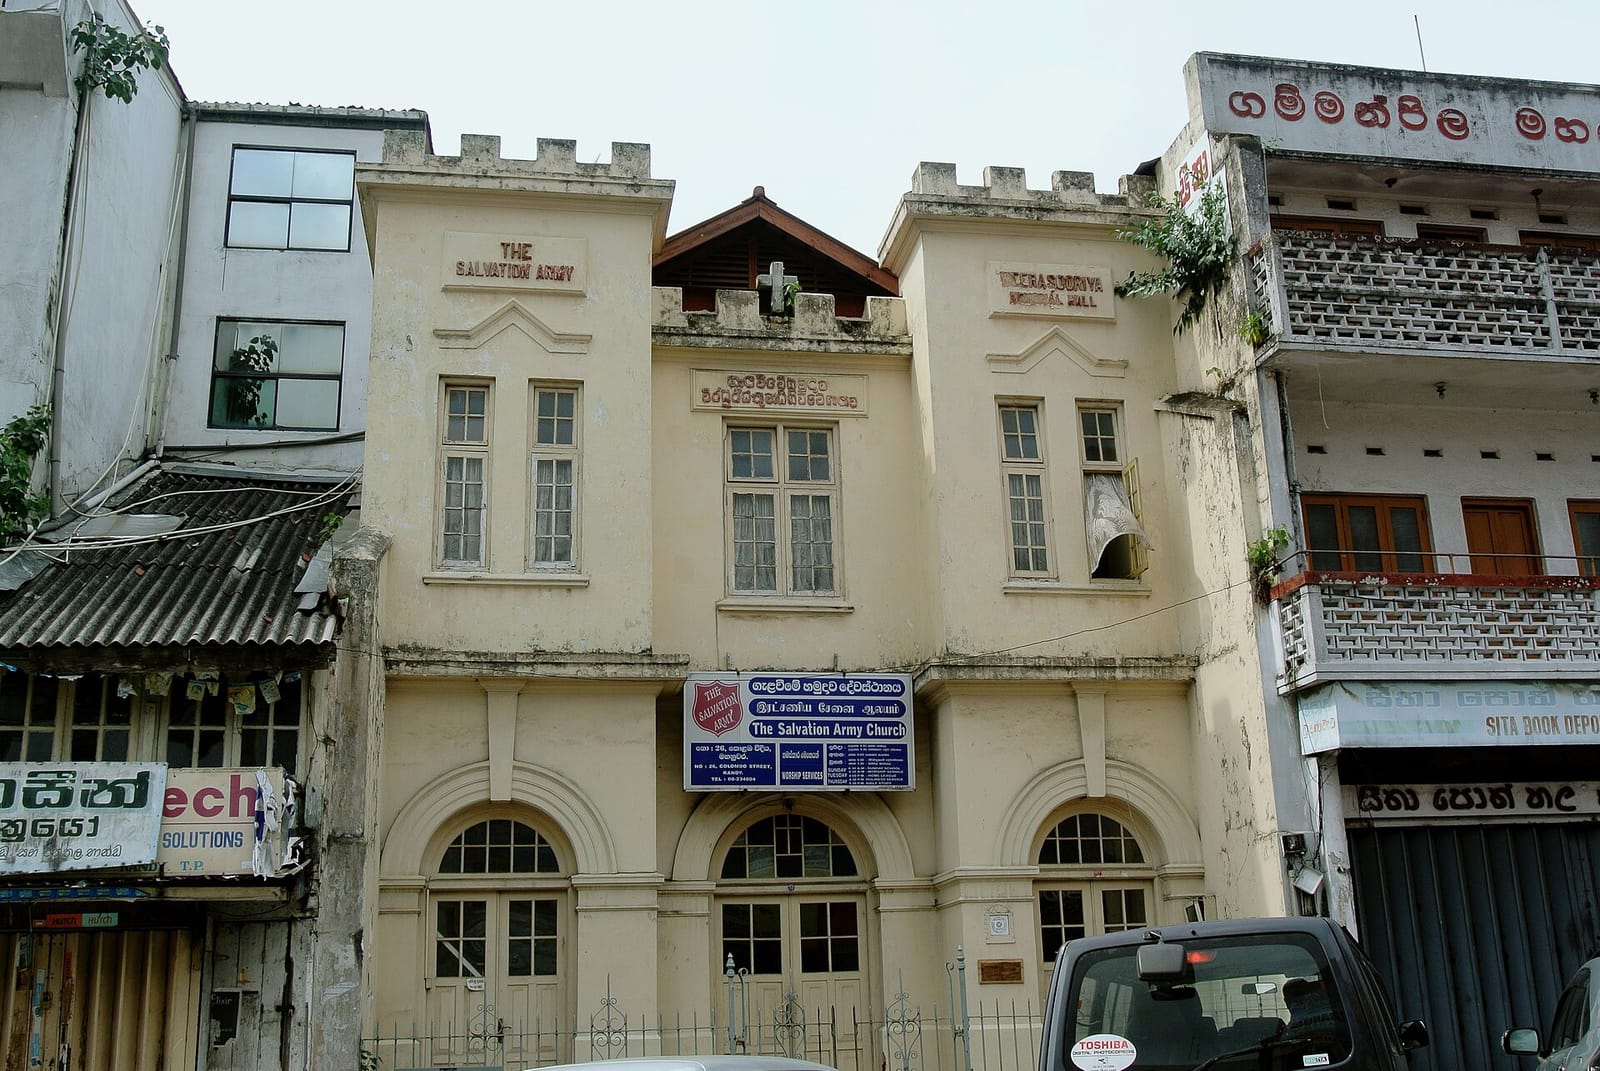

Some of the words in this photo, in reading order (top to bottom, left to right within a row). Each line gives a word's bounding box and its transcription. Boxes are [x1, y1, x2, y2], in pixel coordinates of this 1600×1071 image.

[1515, 105, 1600, 145] මහ
[500, 241, 533, 262] THE
[455, 260, 531, 280] SALVATION
[535, 264, 575, 282] ARMY
[1066, 294, 1098, 308] HALL
[704, 686, 721, 702] THE
[698, 692, 739, 722] SALVATION
[714, 709, 734, 731] ARMY
[752, 722, 774, 736] The
[778, 721, 830, 737] Salvation
[833, 723, 863, 738] Army
[866, 723, 907, 737] Church
[1485, 715, 1519, 737] SITA
[1522, 715, 1561, 736] BOOK
[1563, 714, 1600, 735] DEPO
[162, 831, 244, 849] SOLUTIONS
[180, 860, 205, 872] T.P.
[1079, 1040, 1129, 1050] TOSHIBA
